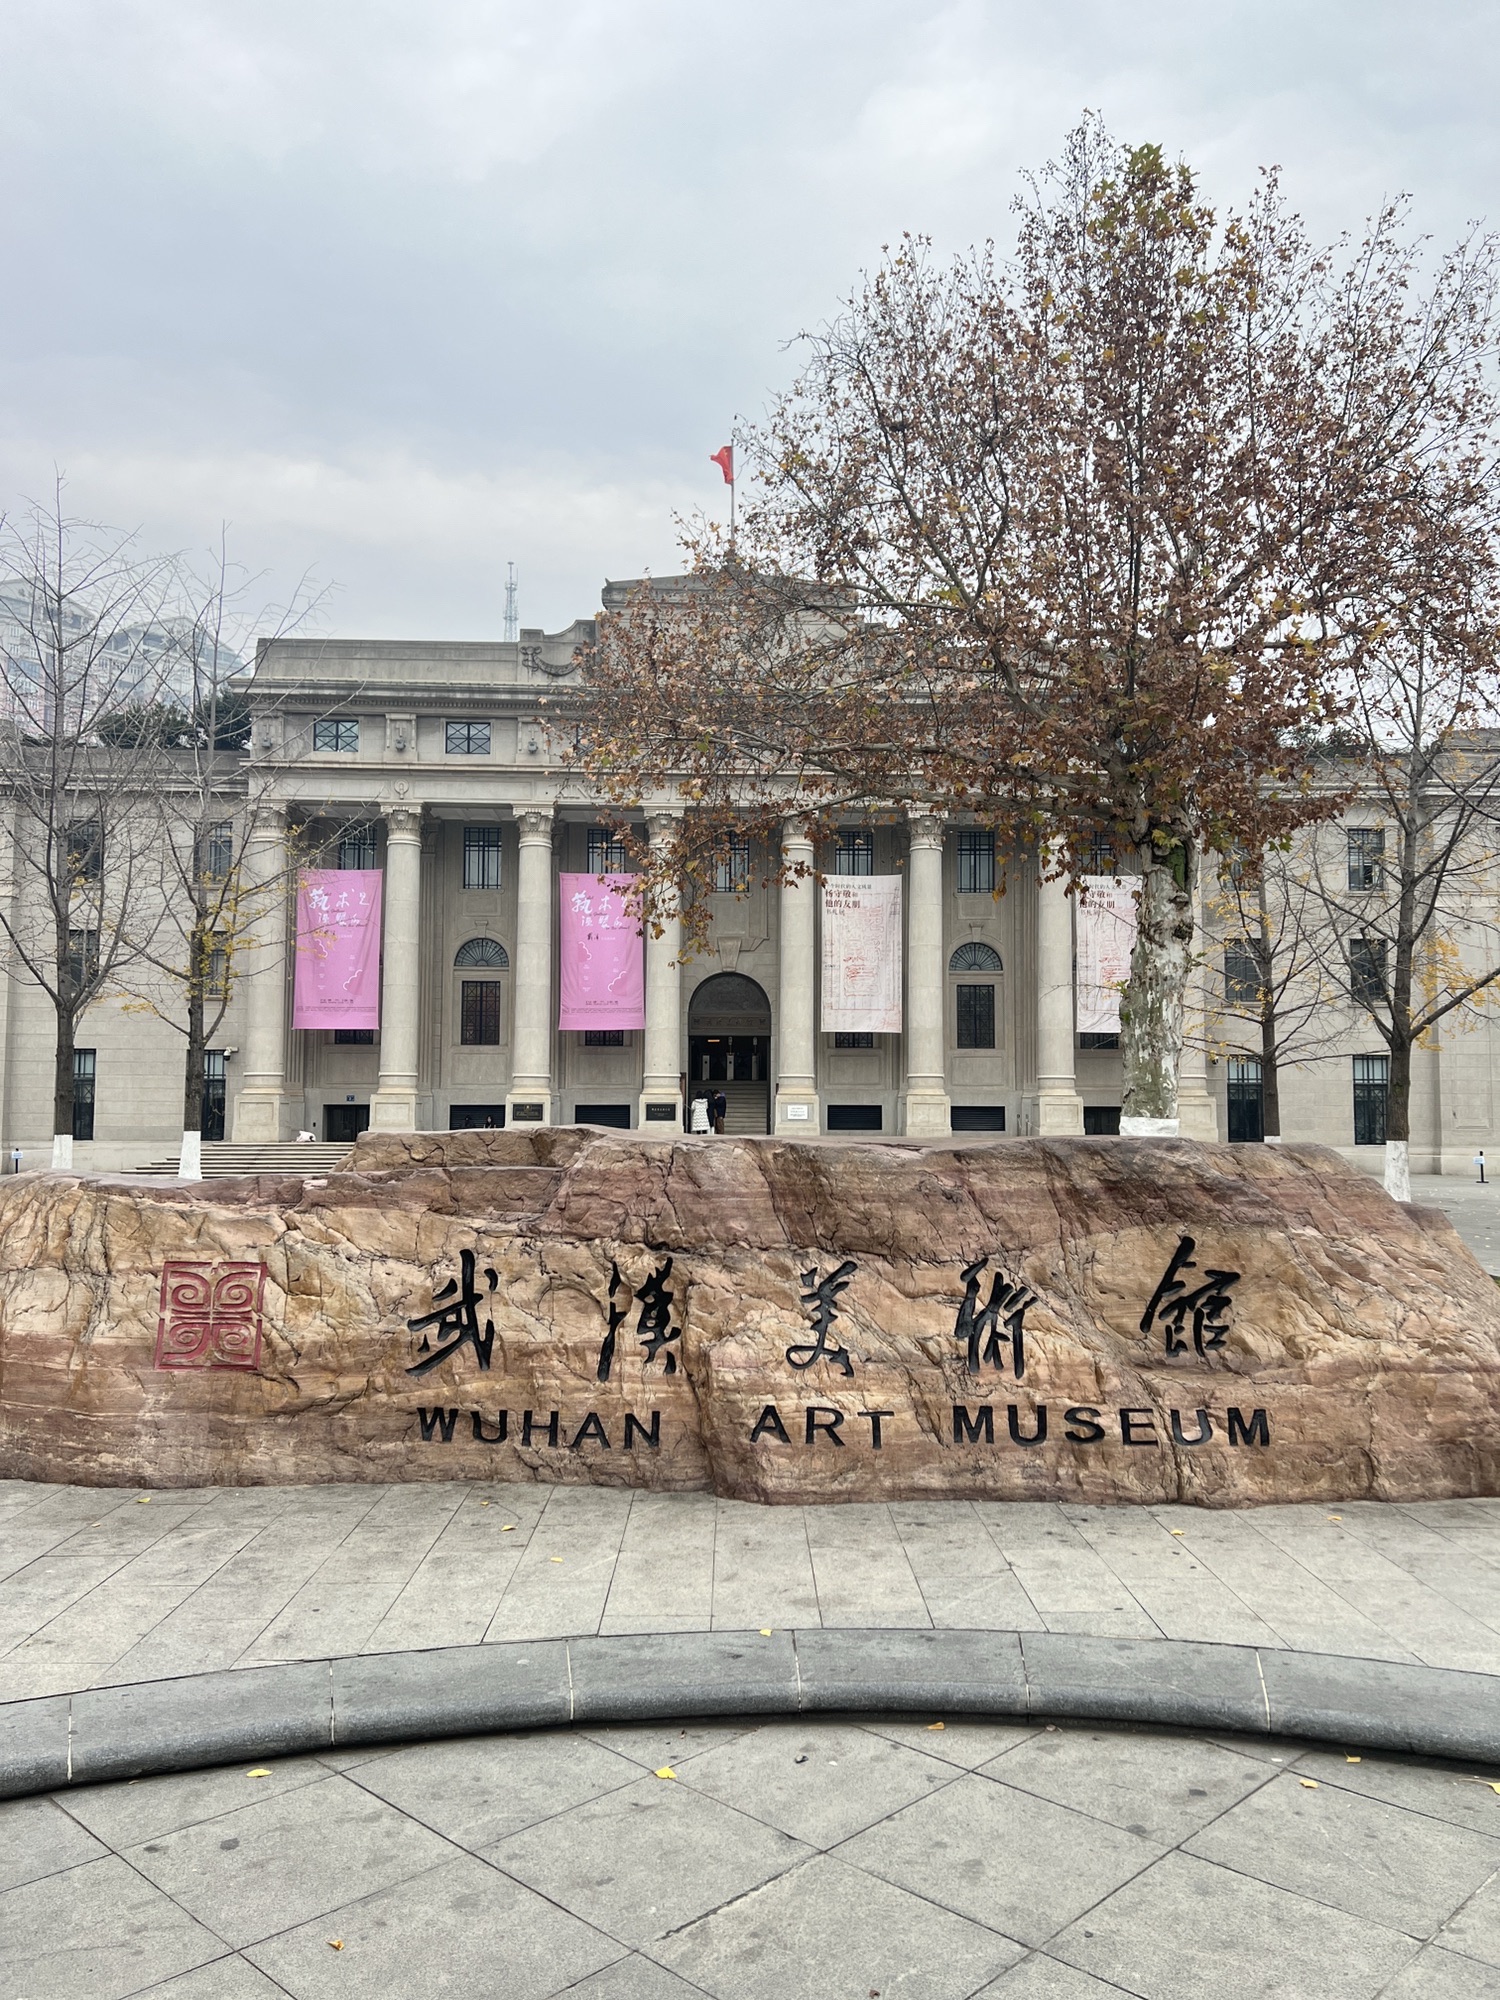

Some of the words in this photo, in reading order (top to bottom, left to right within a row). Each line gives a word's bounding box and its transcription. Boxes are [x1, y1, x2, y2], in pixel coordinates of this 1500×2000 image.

[416, 1406, 661, 1450] WUHAN
[749, 1404, 895, 1450] ART
[952, 1404, 1271, 1448] MUSEUM
